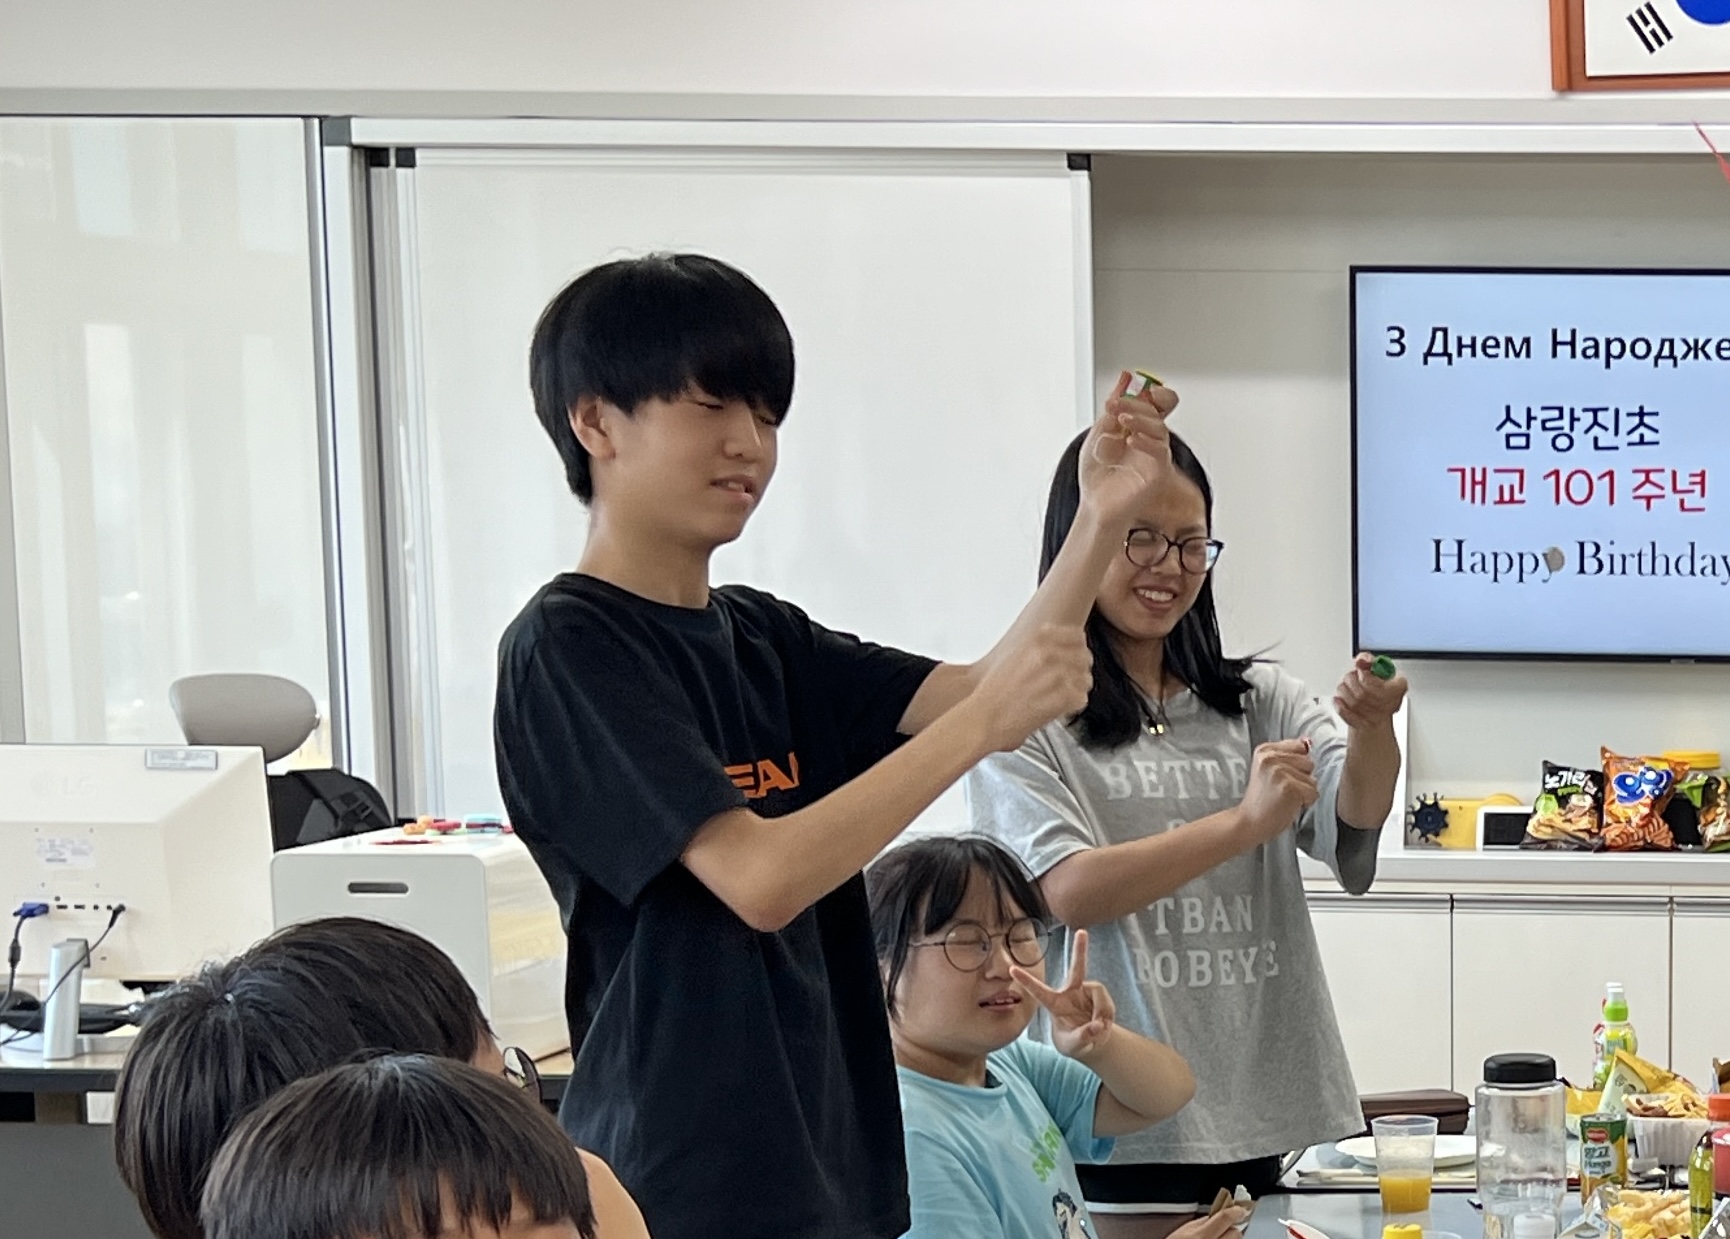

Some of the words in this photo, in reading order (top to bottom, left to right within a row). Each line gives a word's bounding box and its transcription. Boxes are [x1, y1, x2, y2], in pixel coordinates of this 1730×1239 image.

[1423, 327, 1532, 365] Днем
[1496, 404, 1661, 452] 삼랑진초
[1447, 466, 1525, 507] 개교
[1544, 467, 1616, 505] 101
[1631, 467, 1707, 513] 주년
[1431, 538, 1556, 584] Happy
